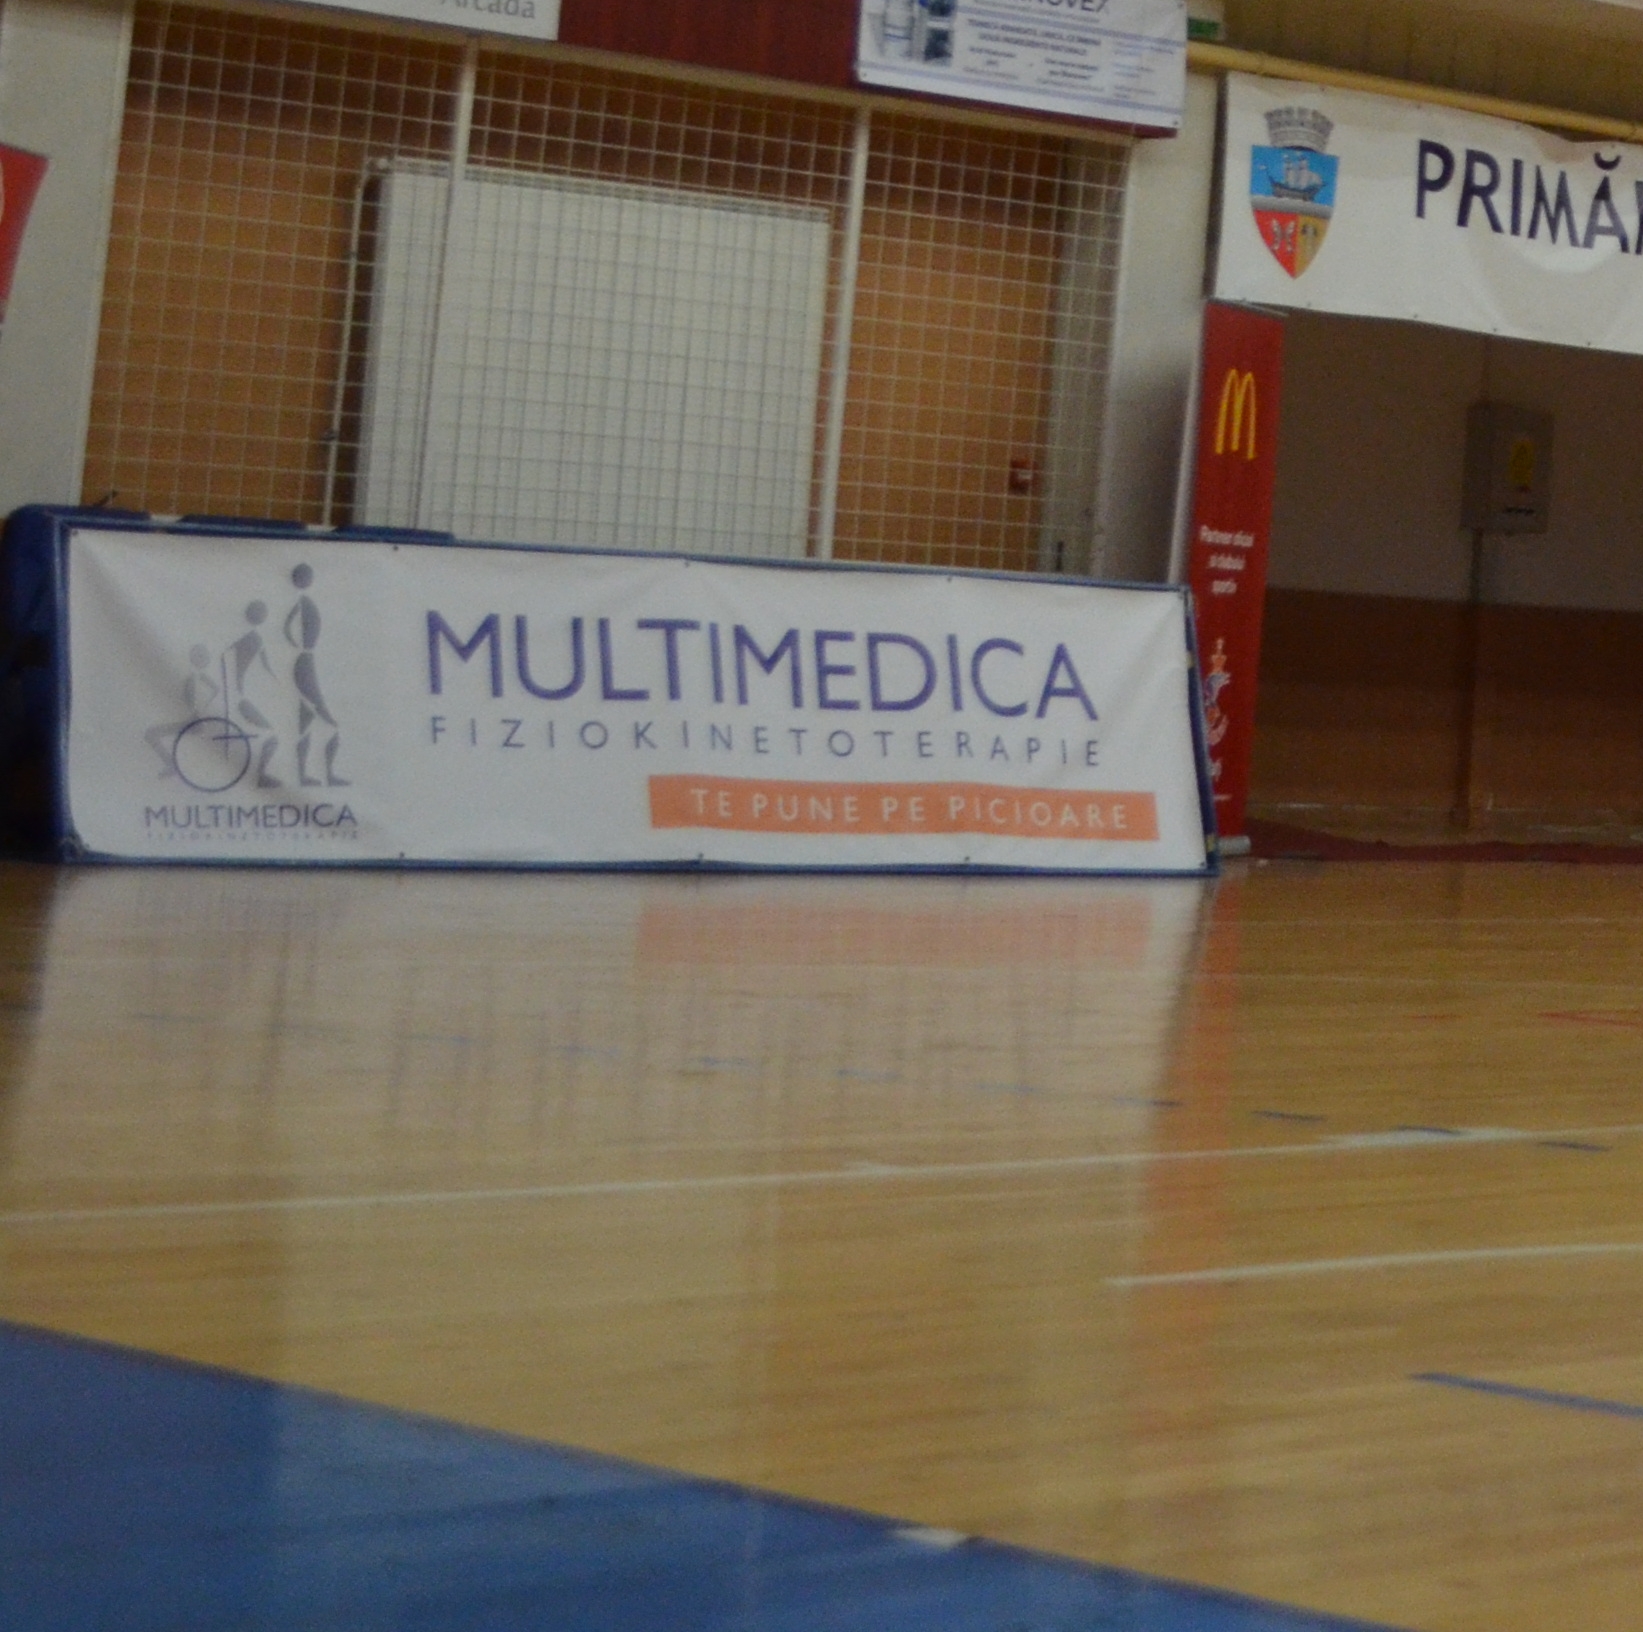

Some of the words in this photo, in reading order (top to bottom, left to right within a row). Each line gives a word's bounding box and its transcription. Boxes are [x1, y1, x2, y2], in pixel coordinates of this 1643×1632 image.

[426, 609, 1099, 721] MULTIMEDICA
[144, 802, 359, 829] MULTIMEDICA
[690, 788, 733, 819] TE
[752, 792, 861, 823] PUNE
[880, 795, 926, 823] PE
[947, 796, 1128, 830] PICIOARE
